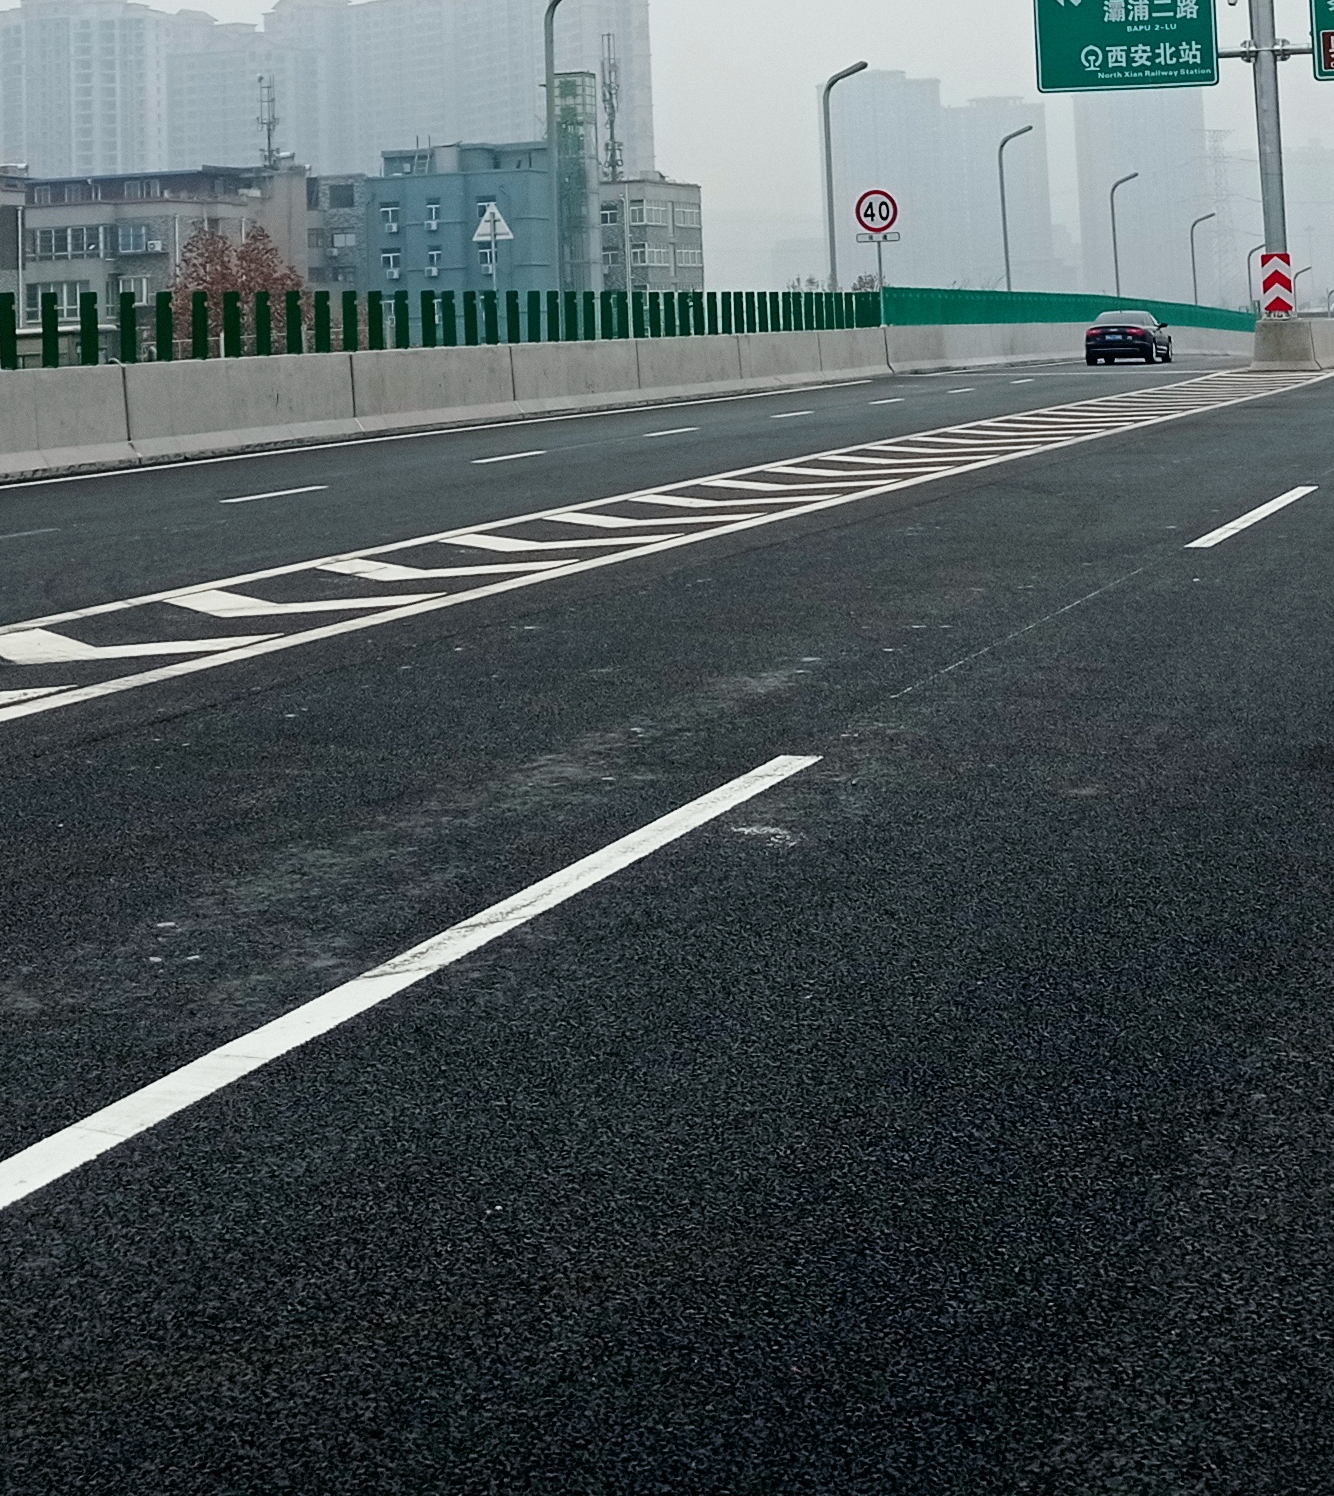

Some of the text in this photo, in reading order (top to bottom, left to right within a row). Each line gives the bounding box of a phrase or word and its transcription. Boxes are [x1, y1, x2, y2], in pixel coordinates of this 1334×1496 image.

[1154, 23, 1177, 31] 2-LU
[1105, 40, 1202, 68] 西安北站
[1098, 71, 1122, 79] North
[1144, 69, 1178, 77] Railway
[863, 201, 890, 222] 40
